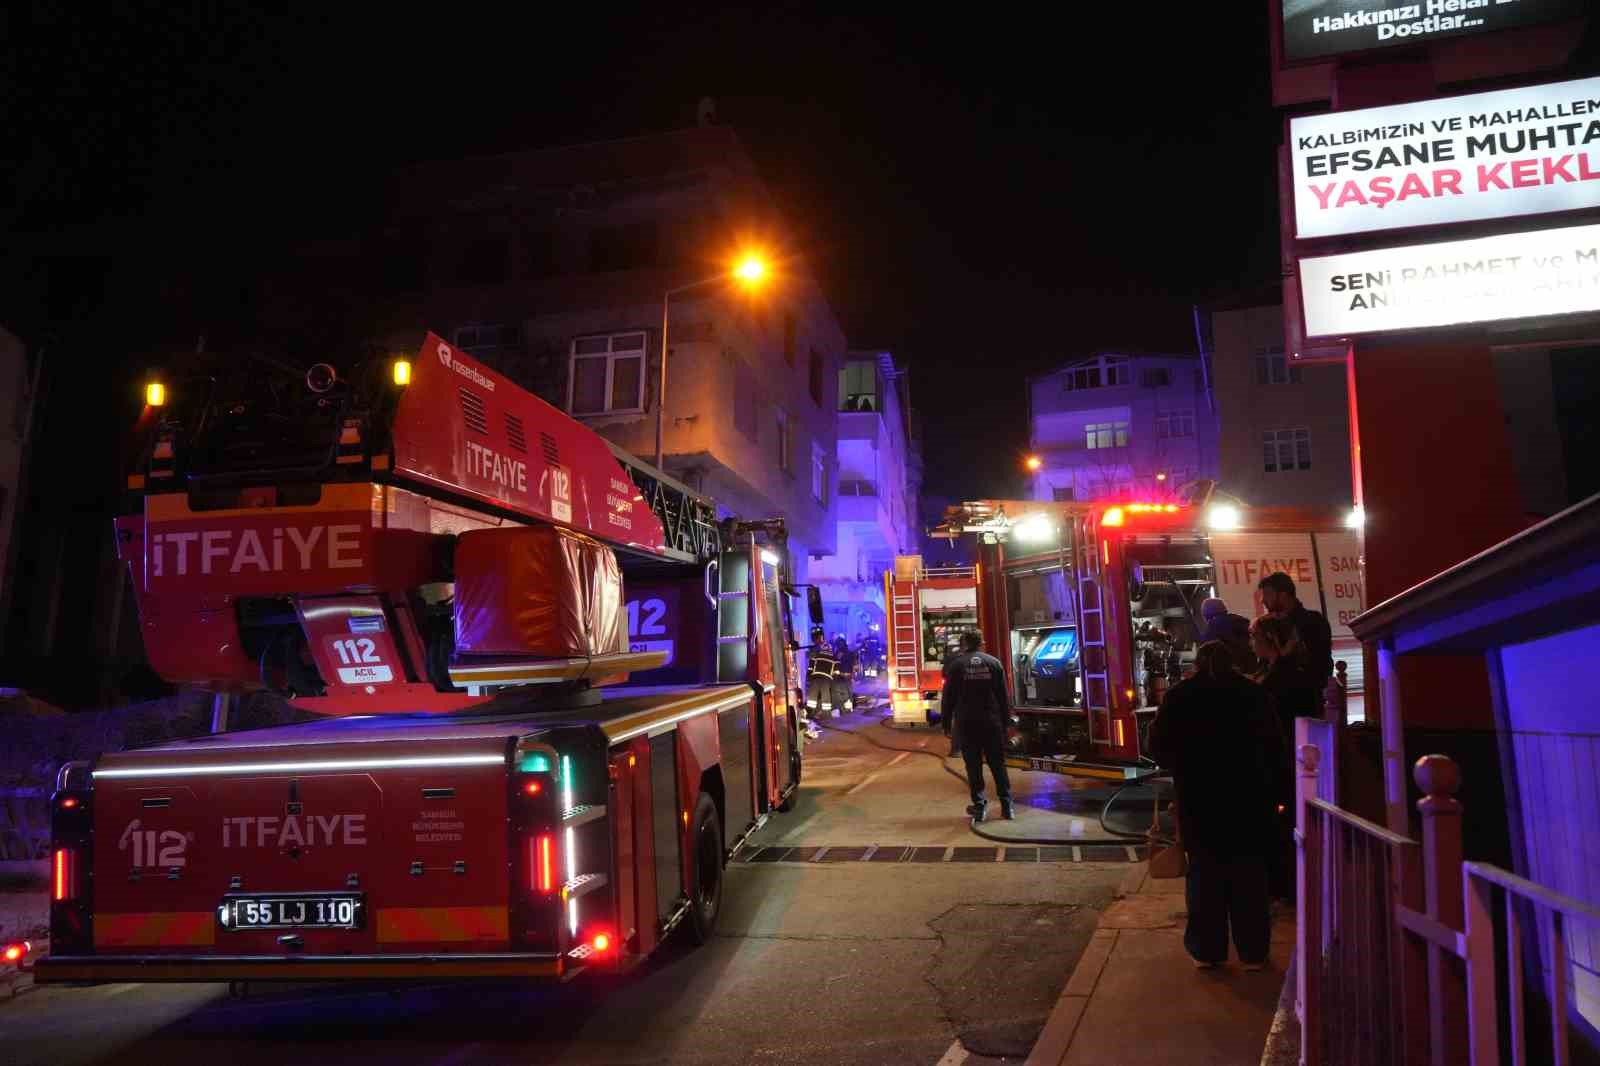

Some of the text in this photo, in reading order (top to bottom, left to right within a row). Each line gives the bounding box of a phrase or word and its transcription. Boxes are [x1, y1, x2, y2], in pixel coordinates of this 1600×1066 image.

[1313, 4, 1420, 33] Hakkınızı
[1377, 14, 1484, 40] Dostlar...
[1431, 117, 1462, 133] VE
[1306, 119, 1600, 177] EFSANE MUHTA
[1308, 152, 1600, 210] YAŞAR KEKL
[552, 469, 569, 500] 112
[333, 638, 381, 664] 112
[131, 830, 188, 868] 112
[247, 901, 352, 924] 55 LJ 110
